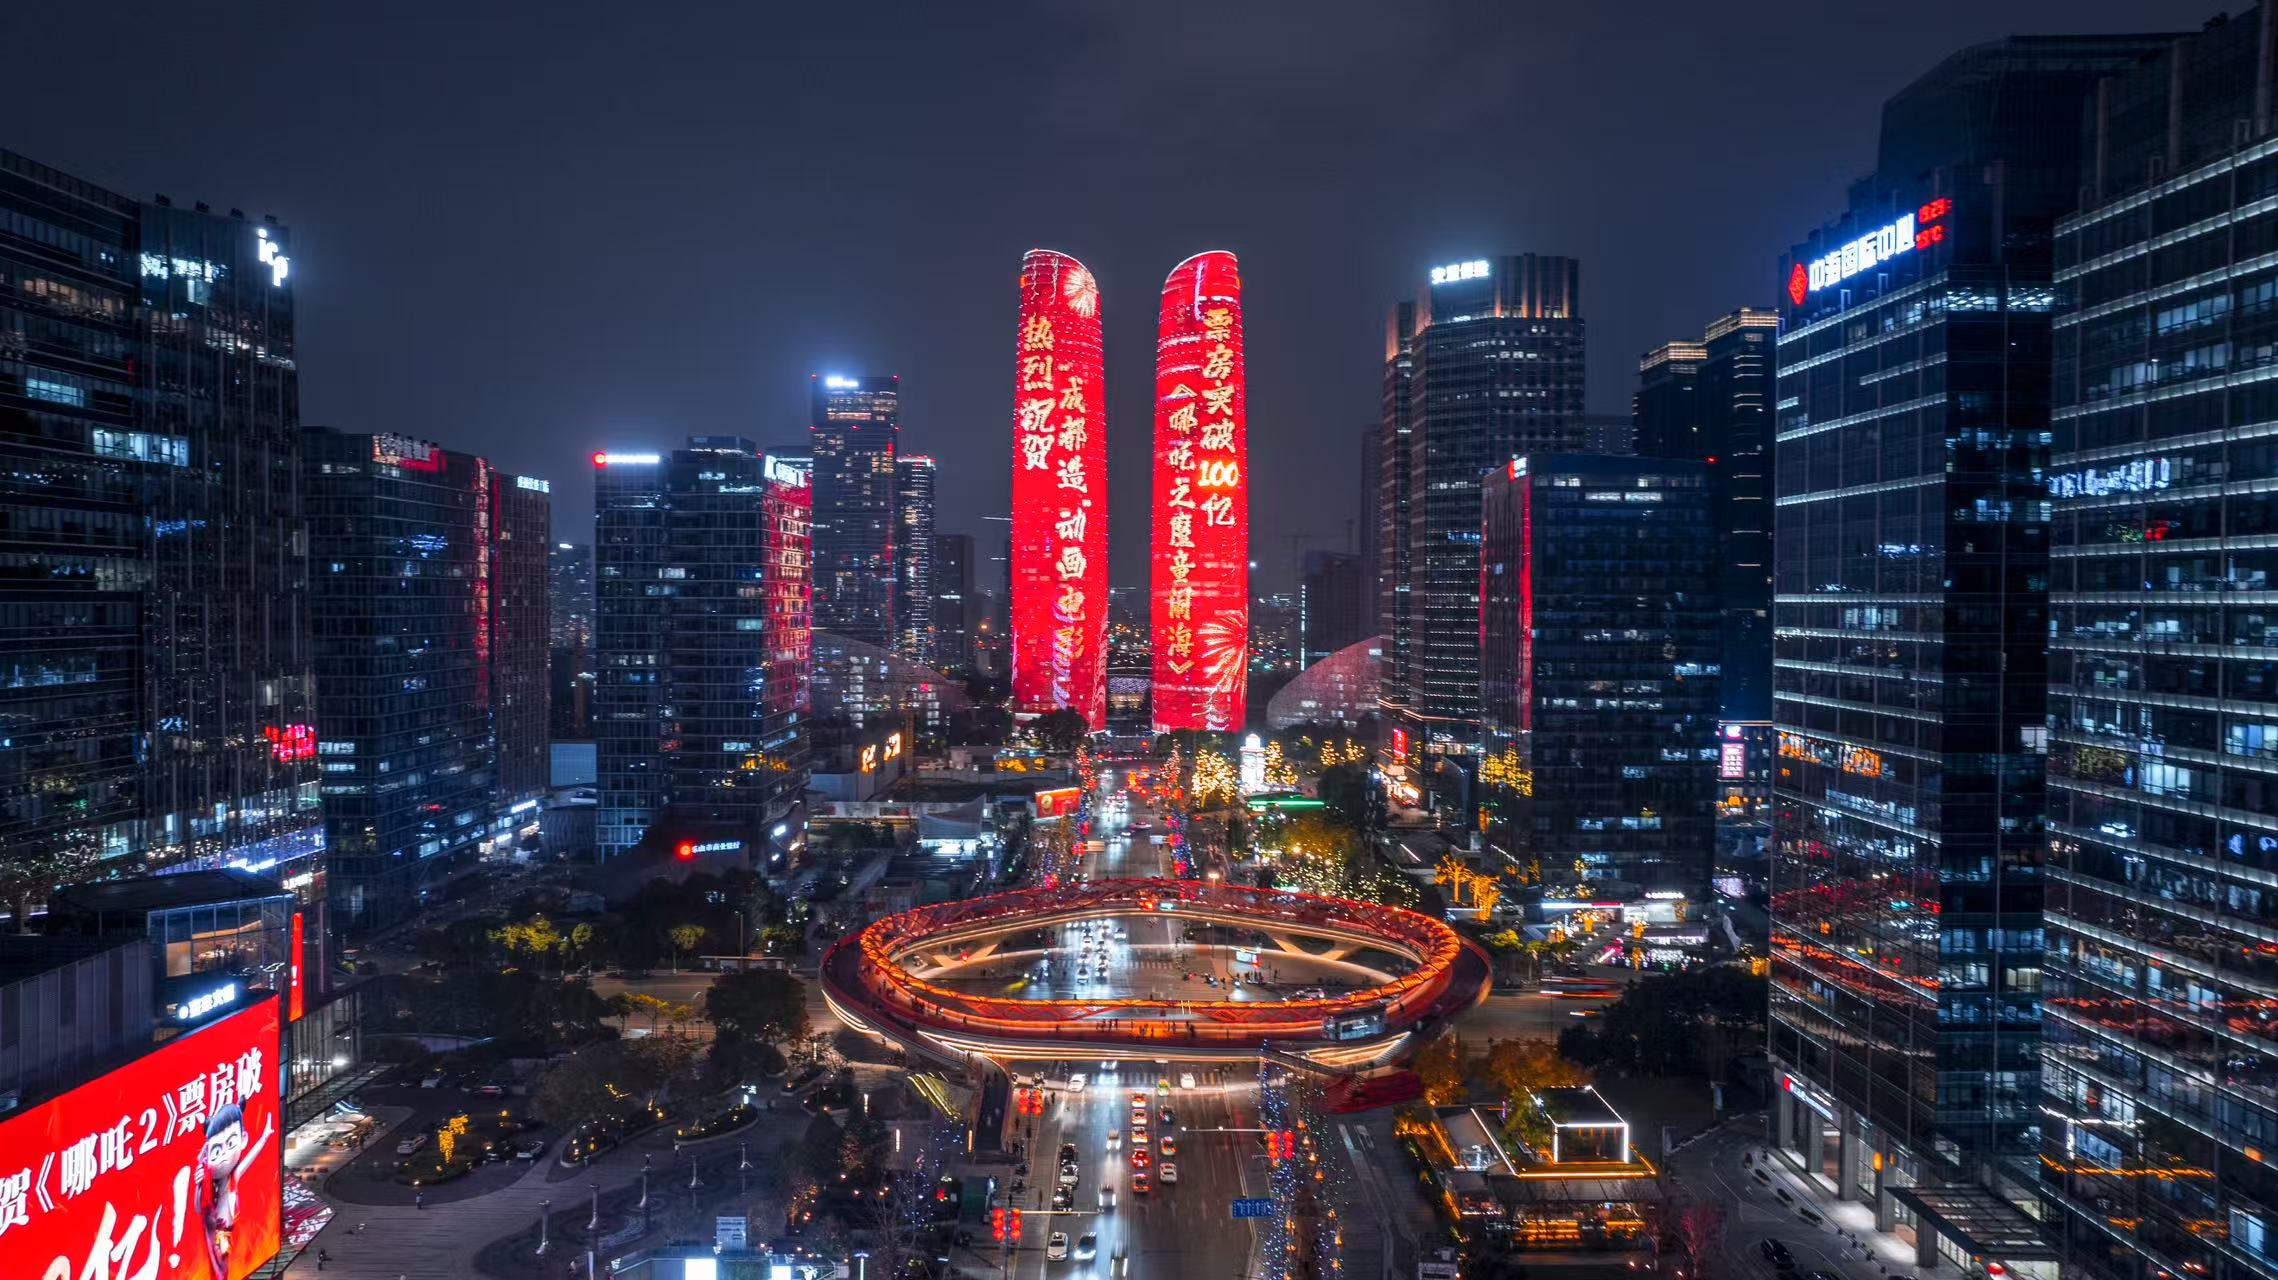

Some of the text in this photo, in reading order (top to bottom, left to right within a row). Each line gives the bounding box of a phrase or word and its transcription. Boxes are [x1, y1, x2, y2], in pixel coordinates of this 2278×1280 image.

[1808, 213, 1915, 292] 中海国际中心
[1020, 313, 1056, 471] 热烈祝贺
[1197, 307, 1240, 528] 票房突破100亿
[1166, 383, 1200, 675] 《哪吒之魔童闹海》
